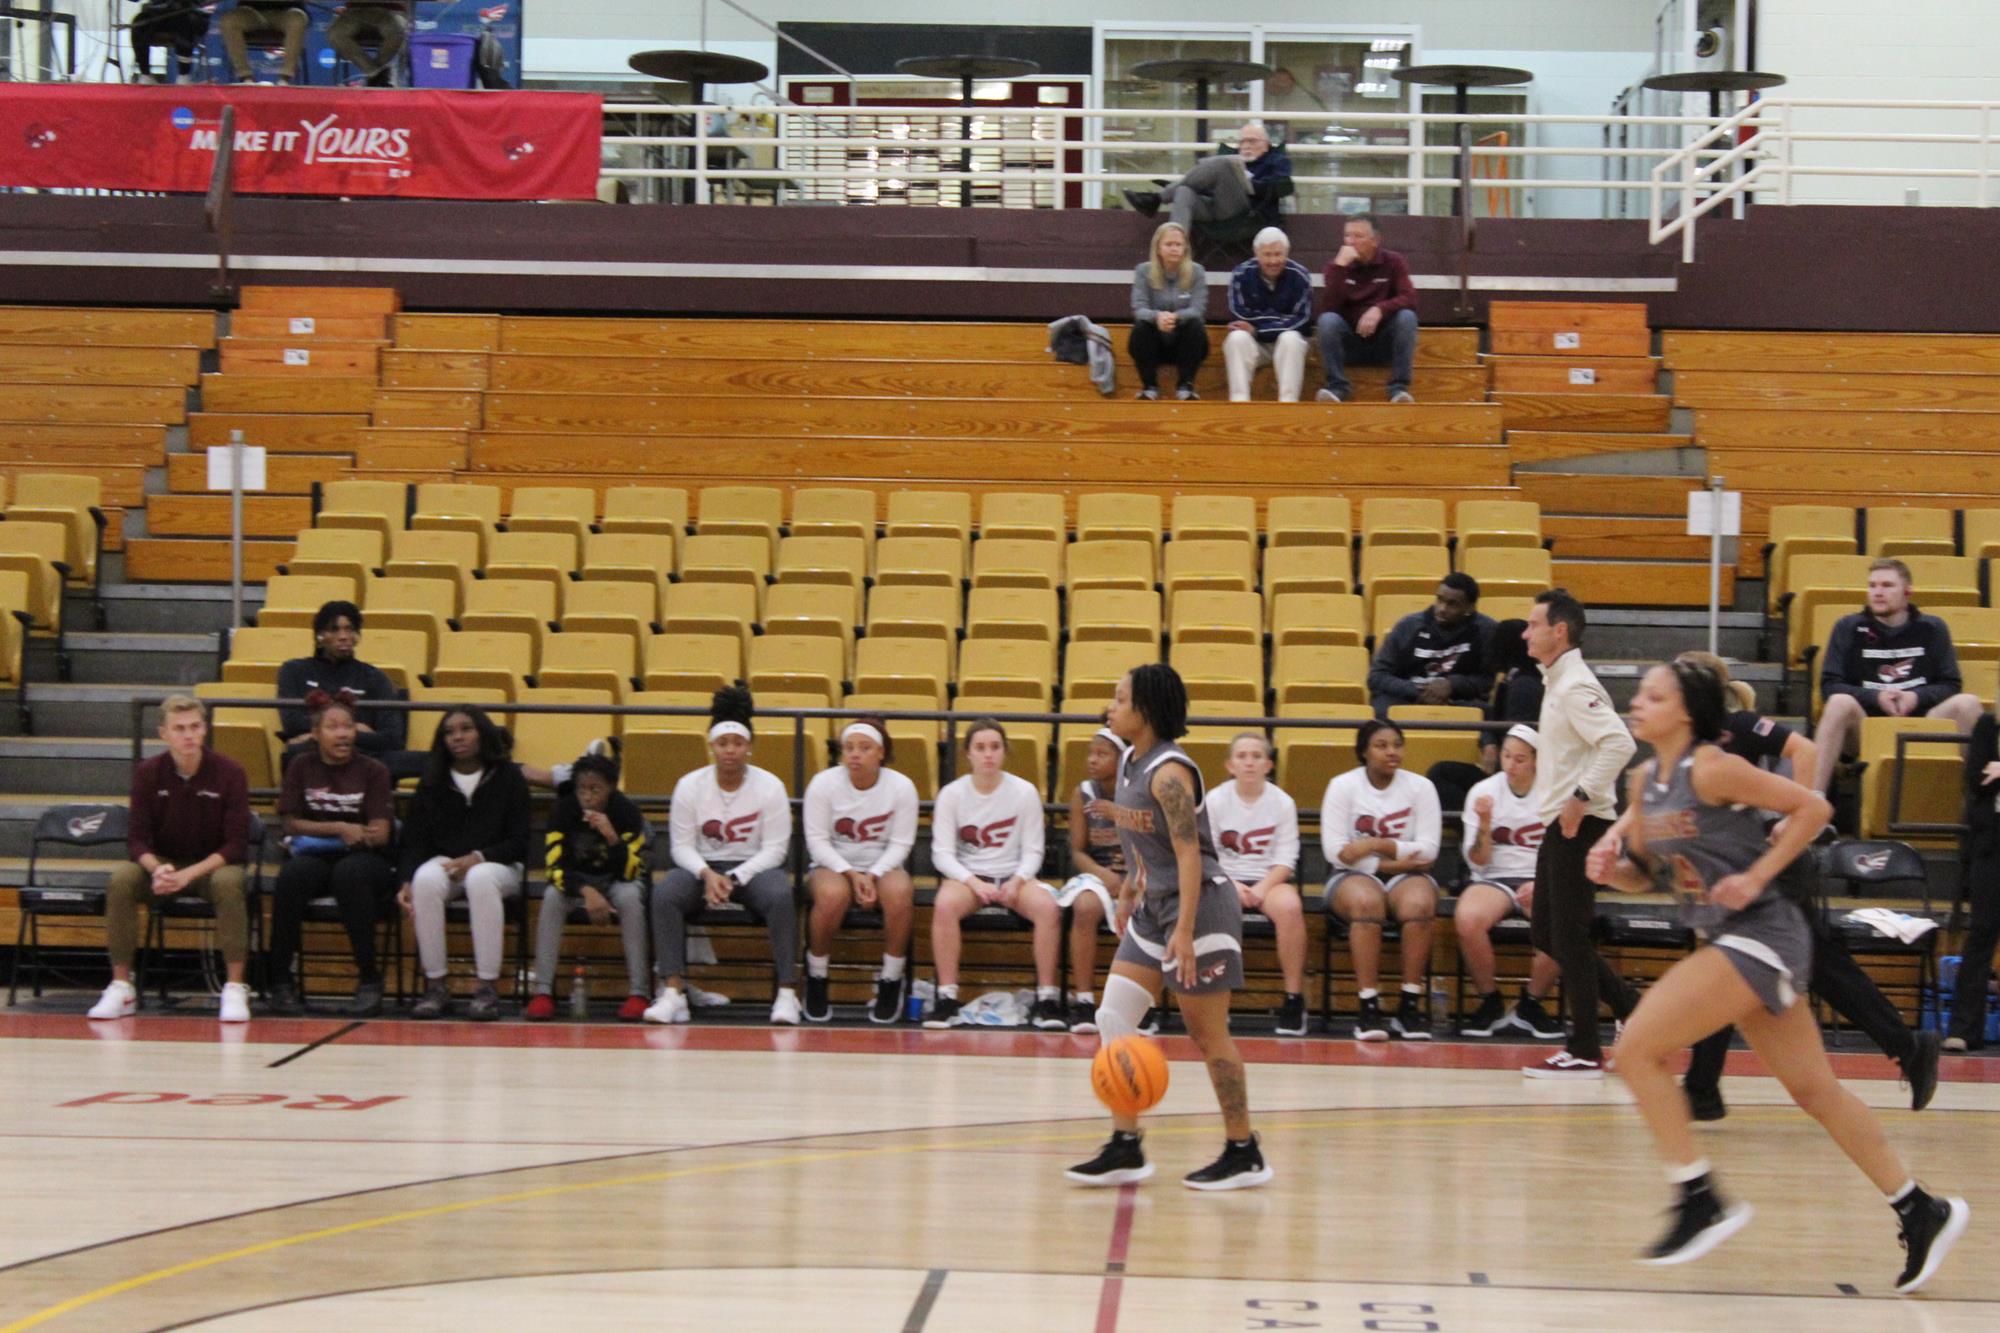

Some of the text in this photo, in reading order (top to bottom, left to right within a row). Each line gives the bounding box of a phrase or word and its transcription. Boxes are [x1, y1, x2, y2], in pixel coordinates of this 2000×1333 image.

[189, 113, 410, 165] MKE IT YOURS
